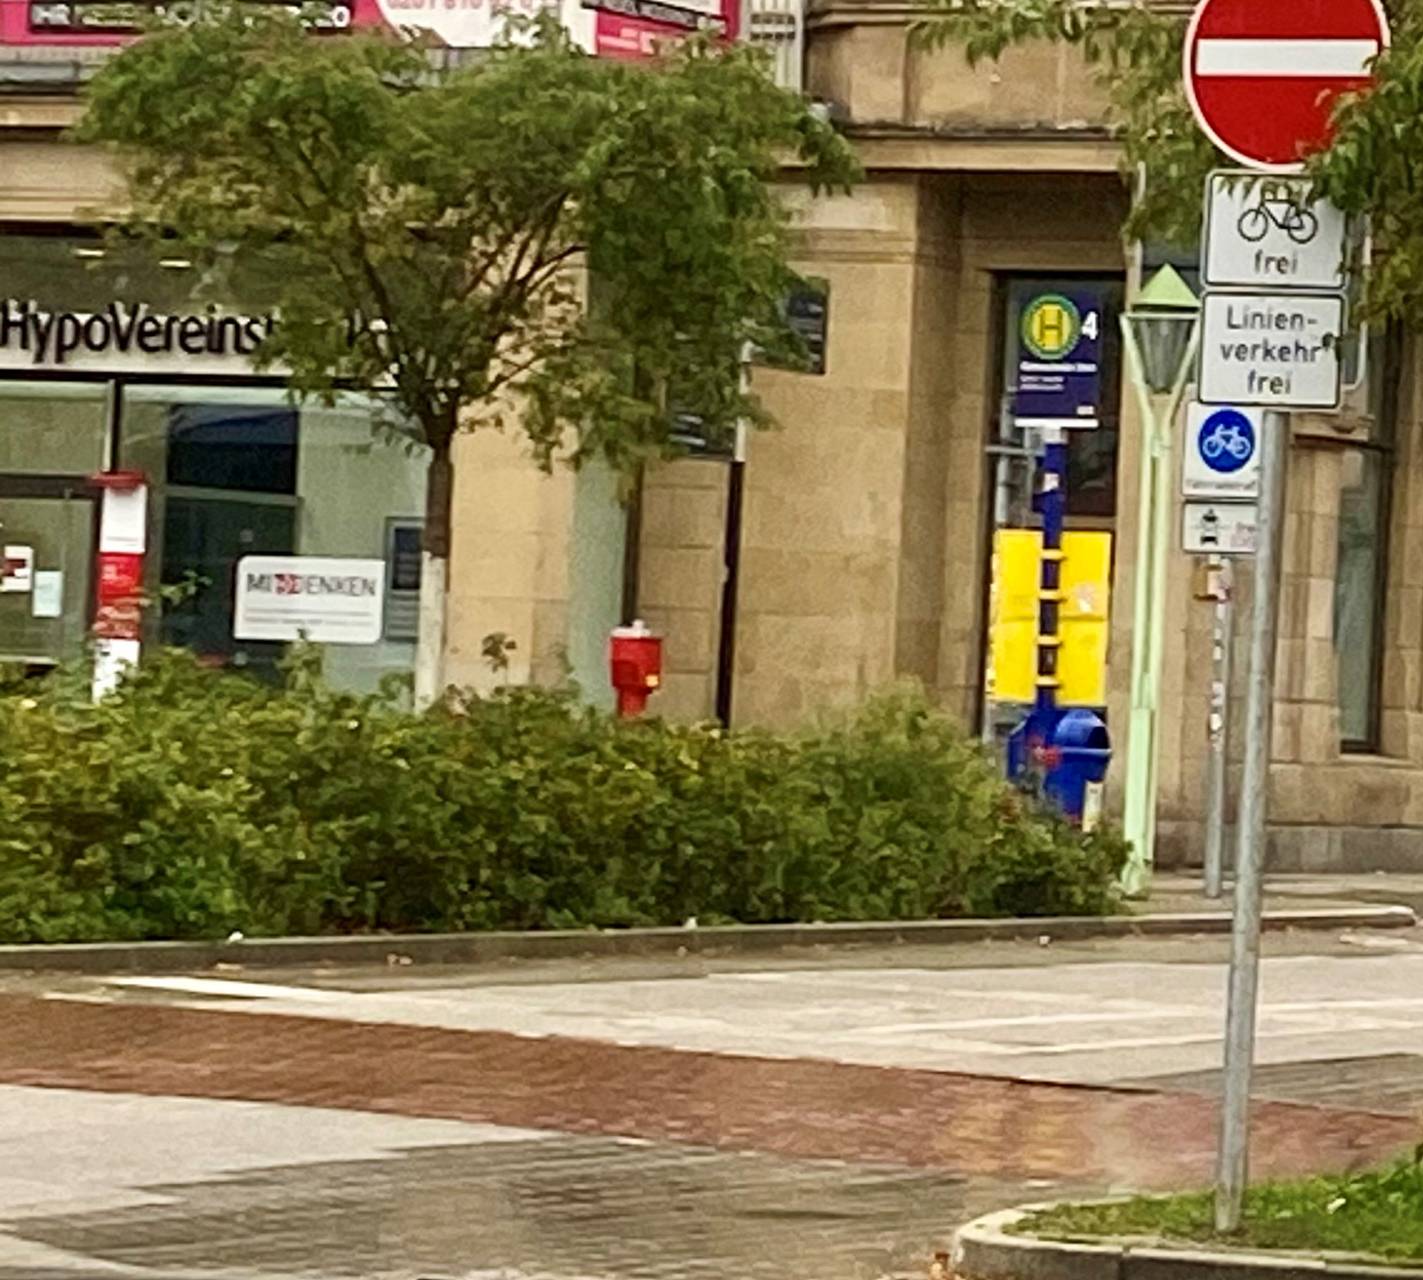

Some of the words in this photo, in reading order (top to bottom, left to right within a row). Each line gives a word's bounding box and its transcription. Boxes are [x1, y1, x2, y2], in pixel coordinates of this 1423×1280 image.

[1255, 249, 1298, 274] frei
[1039, 308, 1063, 342] H
[1081, 311, 1098, 340] 4
[1226, 305, 1318, 330] Linien-
[1219, 338, 1322, 362] verkehr
[1247, 370, 1293, 395] frei
